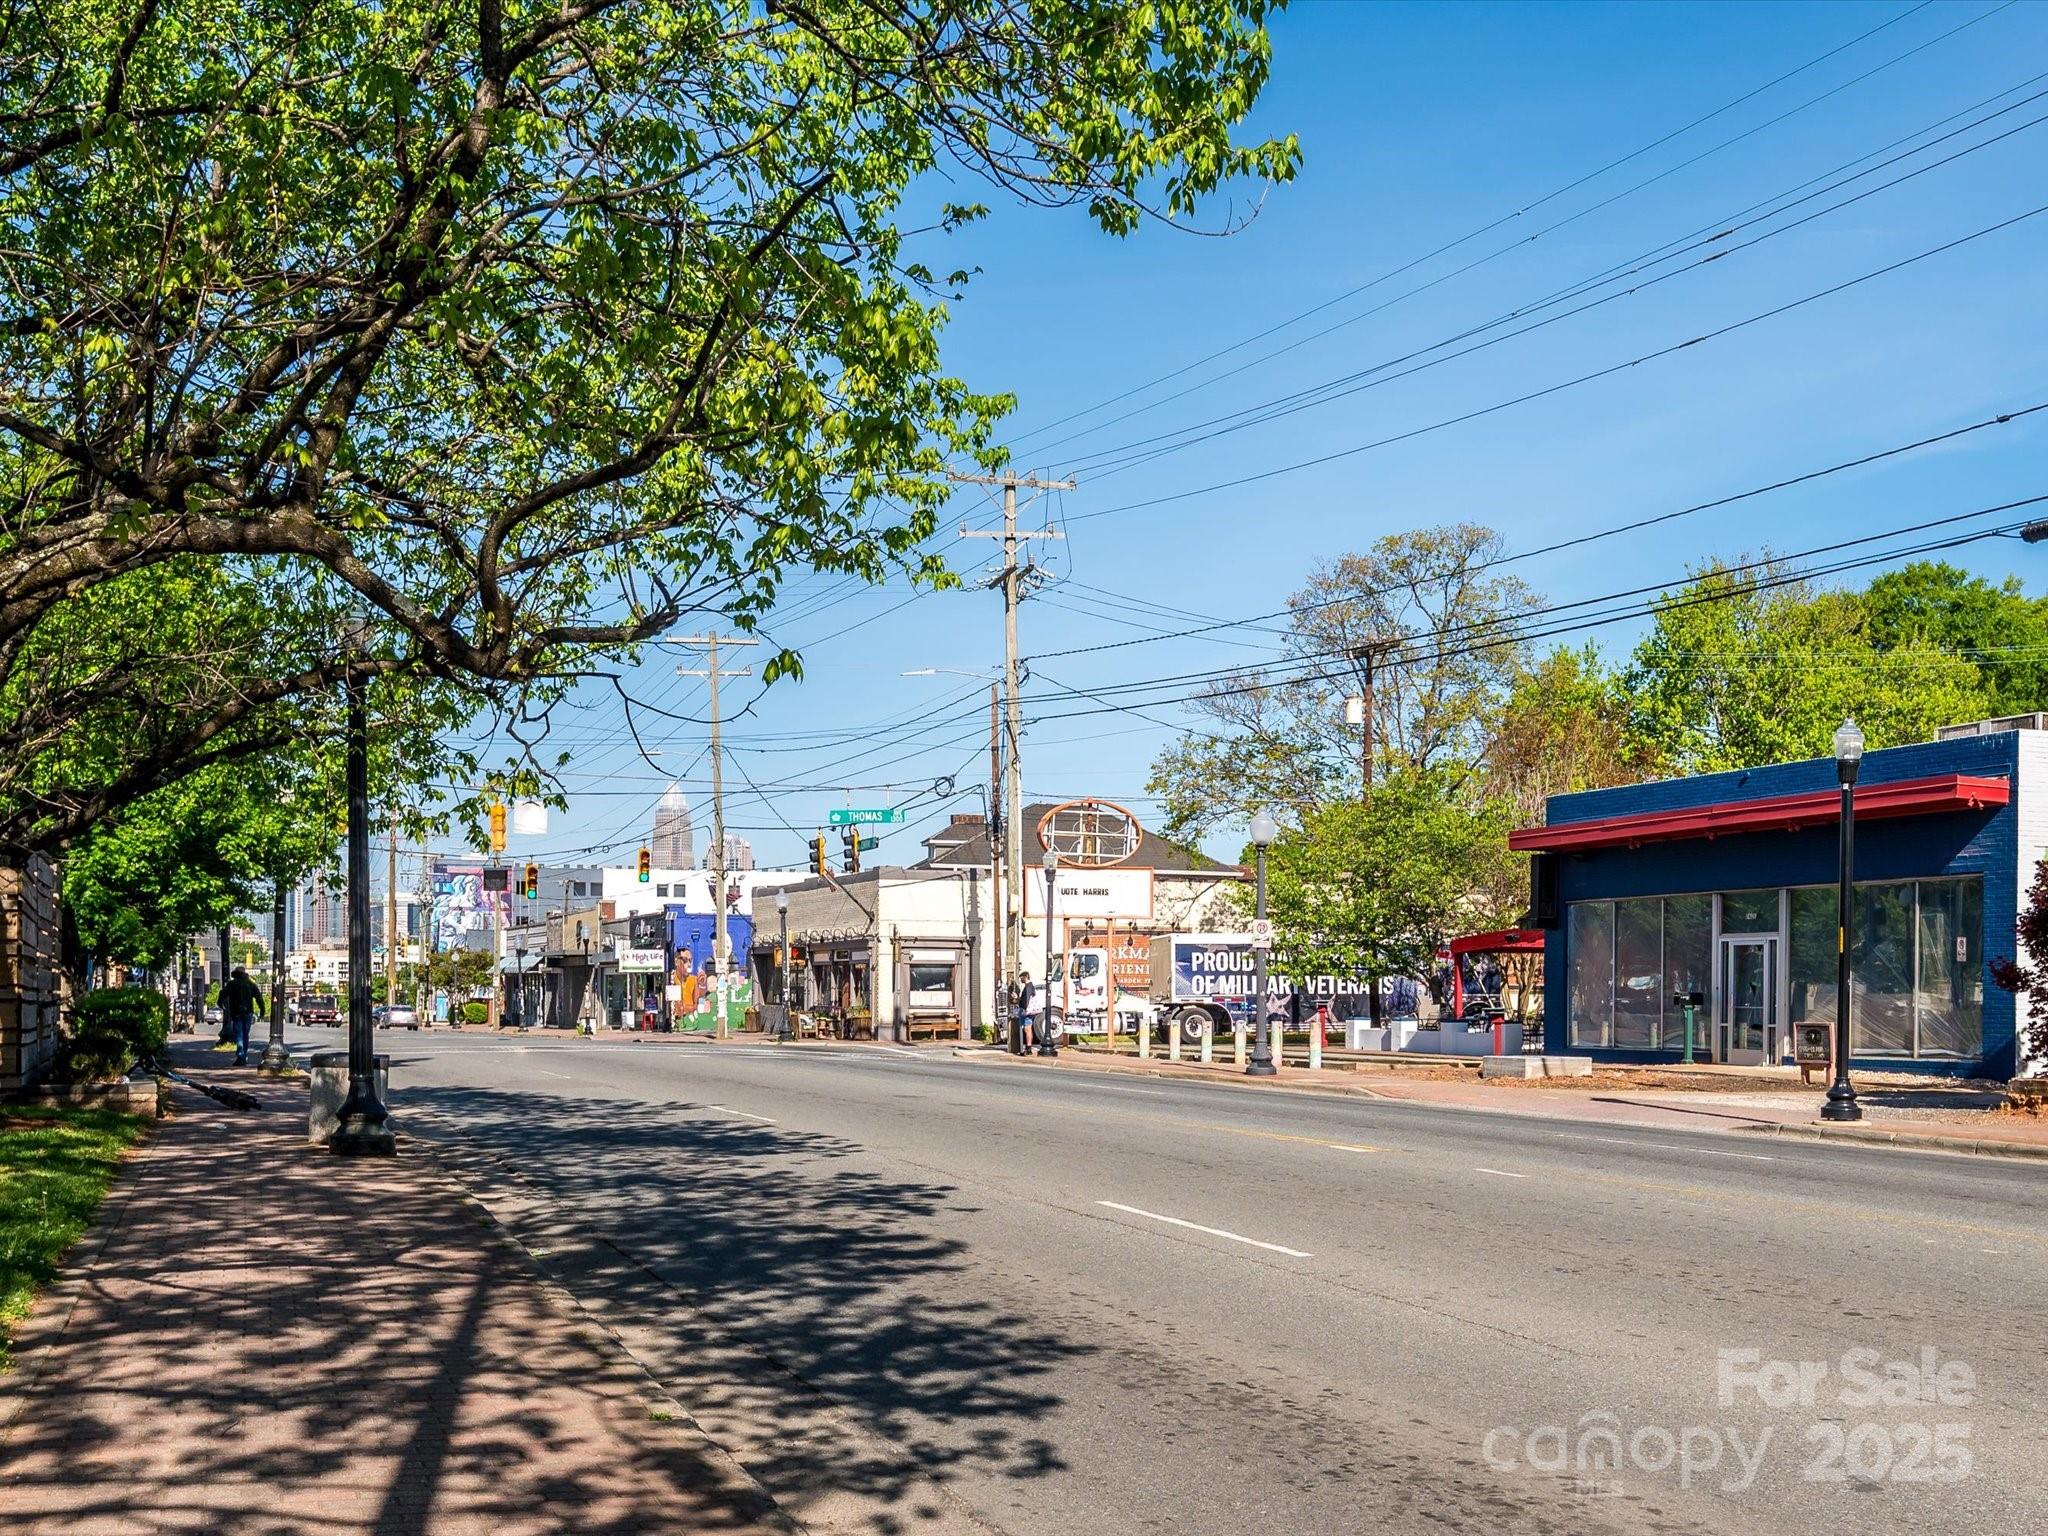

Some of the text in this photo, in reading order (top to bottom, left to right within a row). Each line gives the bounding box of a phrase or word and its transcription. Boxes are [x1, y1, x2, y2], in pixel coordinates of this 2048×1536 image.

[848, 811, 883, 822] THOMAS
[1083, 888, 1109, 896] HARRIS
[632, 952, 649, 965] High
[1191, 951, 1254, 972] PROUD
[1191, 975, 1216, 995] OF
[1219, 975, 1300, 995] MILIAR
